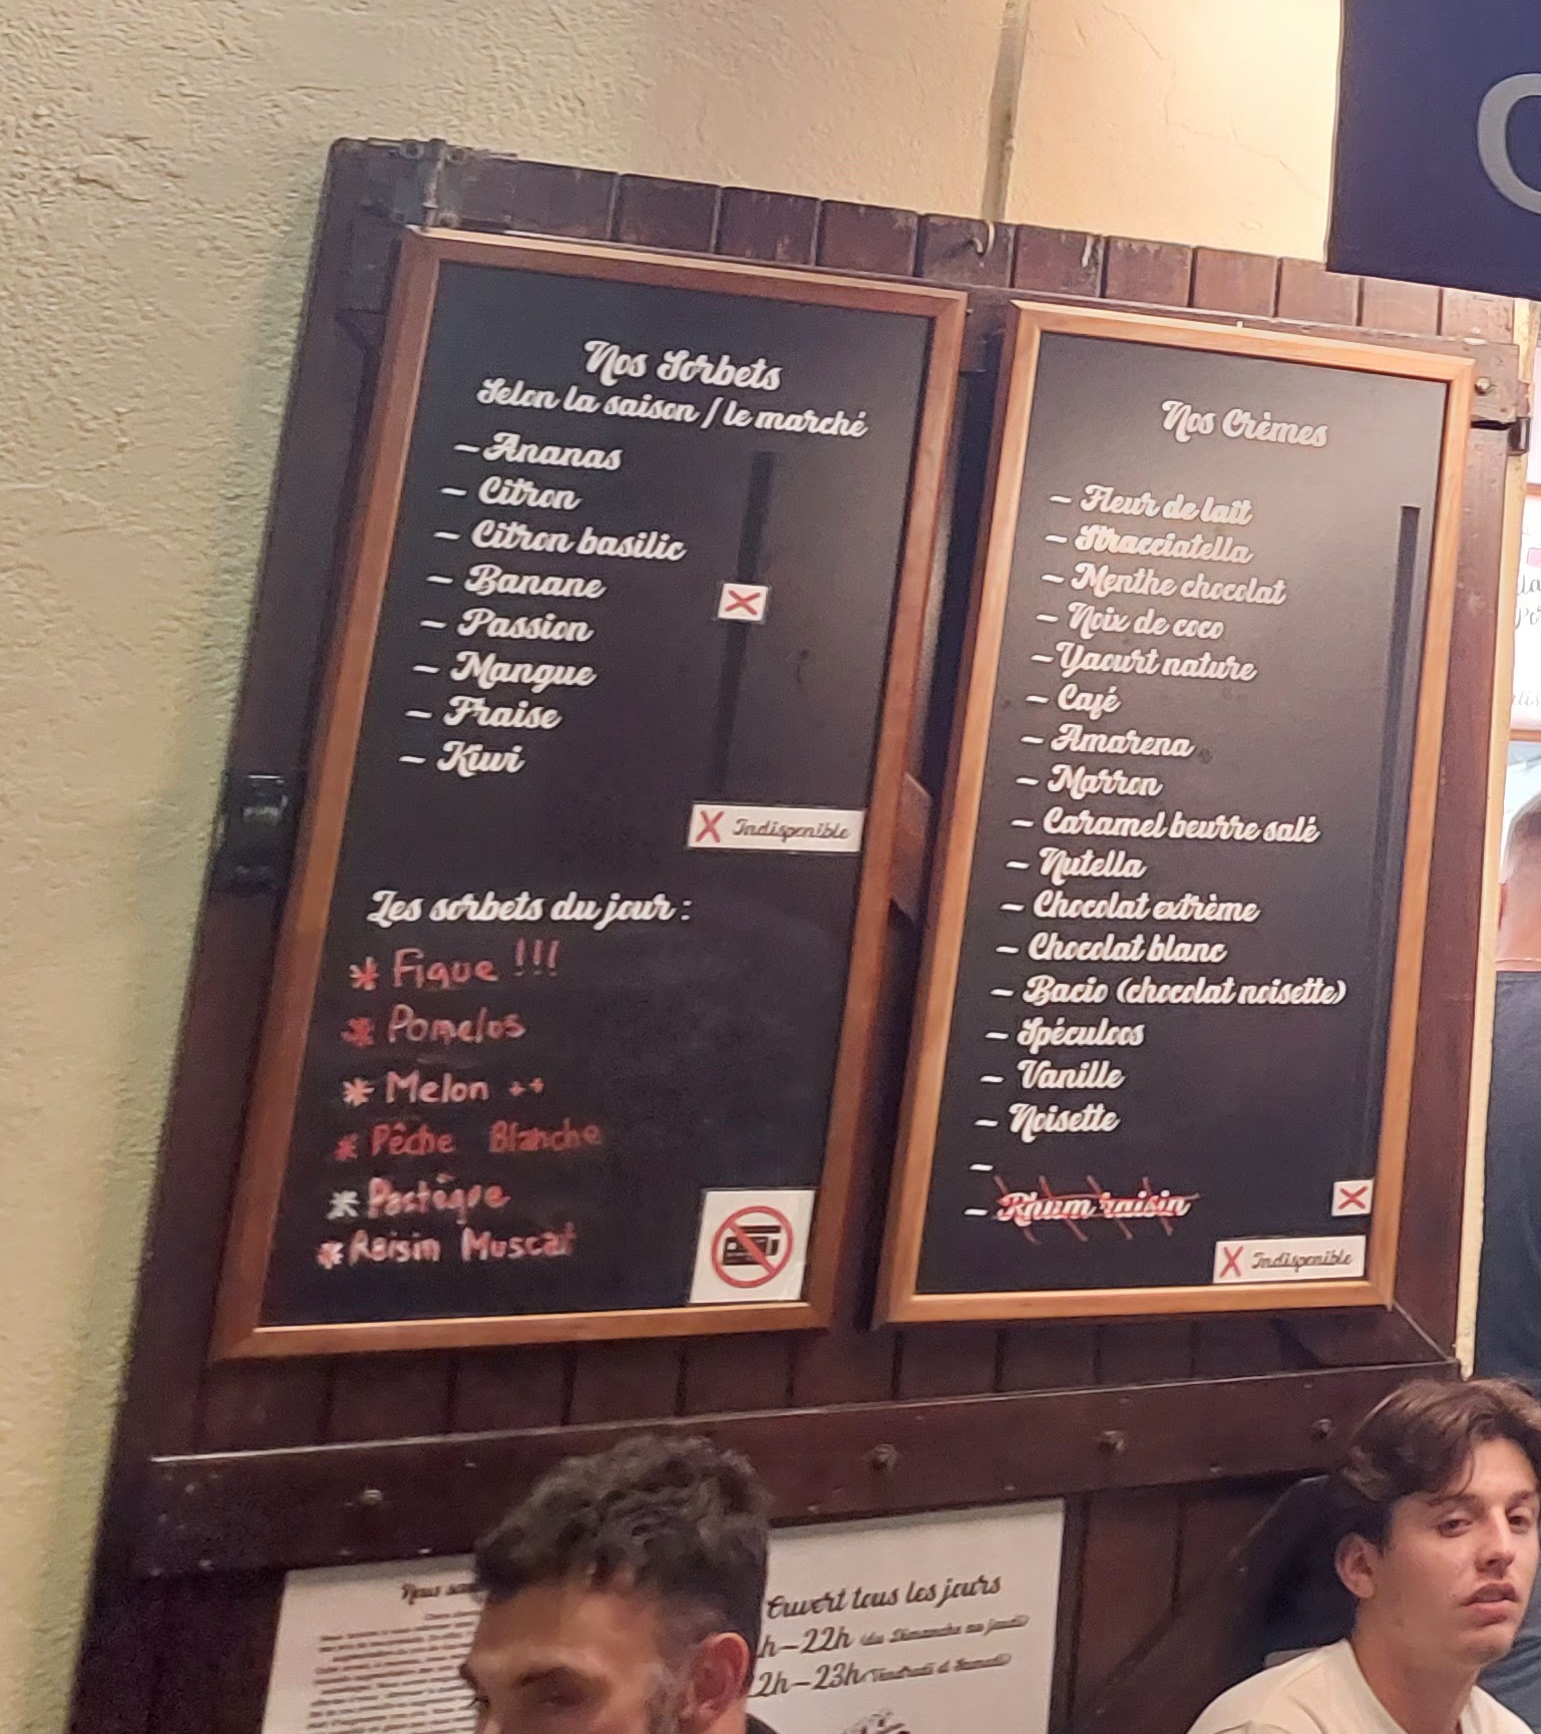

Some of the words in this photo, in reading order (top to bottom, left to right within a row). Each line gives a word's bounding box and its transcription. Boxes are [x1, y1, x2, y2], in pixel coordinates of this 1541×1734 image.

[585, 340, 648, 386] Nos
[657, 349, 782, 390] Sorbets
[477, 378, 561, 409] Selon
[563, 385, 602, 414] la
[604, 394, 700, 424] saison
[722, 400, 755, 427] le
[754, 410, 869, 437] marché
[1161, 400, 1214, 441] Nos
[1222, 408, 1328, 448] Crèmes
[483, 432, 623, 470] Ananas
[478, 476, 582, 510] Citron
[1080, 484, 1161, 517] Fleur
[1162, 494, 1199, 521] de
[1201, 497, 1253, 525] lait
[472, 519, 575, 553] Citron
[577, 527, 687, 561] basilic
[1075, 526, 1253, 564] Stracciatella
[464, 565, 606, 600] Banane
[1071, 563, 1176, 599] Menthe
[1180, 574, 1286, 606] chocolat
[457, 609, 594, 643] Passion
[1067, 602, 1129, 640] Noix
[1133, 609, 1170, 636] de
[1172, 619, 1224, 640] coco
[449, 651, 597, 693] Mangue
[1055, 642, 1161, 677] Yaourt
[1162, 651, 1257, 681] nature
[443, 695, 562, 730] Fraise
[1057, 685, 1121, 719] Café
[436, 740, 525, 778] Kiwi
[1051, 724, 1194, 758] Amarena
[1048, 765, 1163, 800] Marron
[732, 818, 850, 843] Indisponible
[1043, 807, 1169, 839] Caramel
[1169, 813, 1261, 842] beurre
[1263, 816, 1320, 843] salé
[1039, 847, 1147, 885] Nutella
[366, 891, 423, 928] Les
[429, 891, 546, 922] sorbets
[551, 891, 603, 922] du
[593, 892, 676, 931] jour
[1034, 890, 1150, 921] Chocolat
[1028, 933, 1144, 962] Chocolat
[1147, 935, 1227, 962] blanc
[1023, 975, 1108, 1005] Bacio
[1116, 977, 1236, 1005] (chocolat
[1237, 978, 1347, 1005] noisette)
[1017, 1018, 1144, 1054] Spéculoos
[385, 1070, 489, 1103] Melon
[1017, 1060, 1126, 1090] Vanille
[1009, 1104, 1121, 1143] Noisette
[1252, 1251, 1352, 1273] Indisponible
[852, 1586, 898, 1609] tous
[906, 1581, 937, 1604] les
[936, 1575, 1002, 1608] jours
